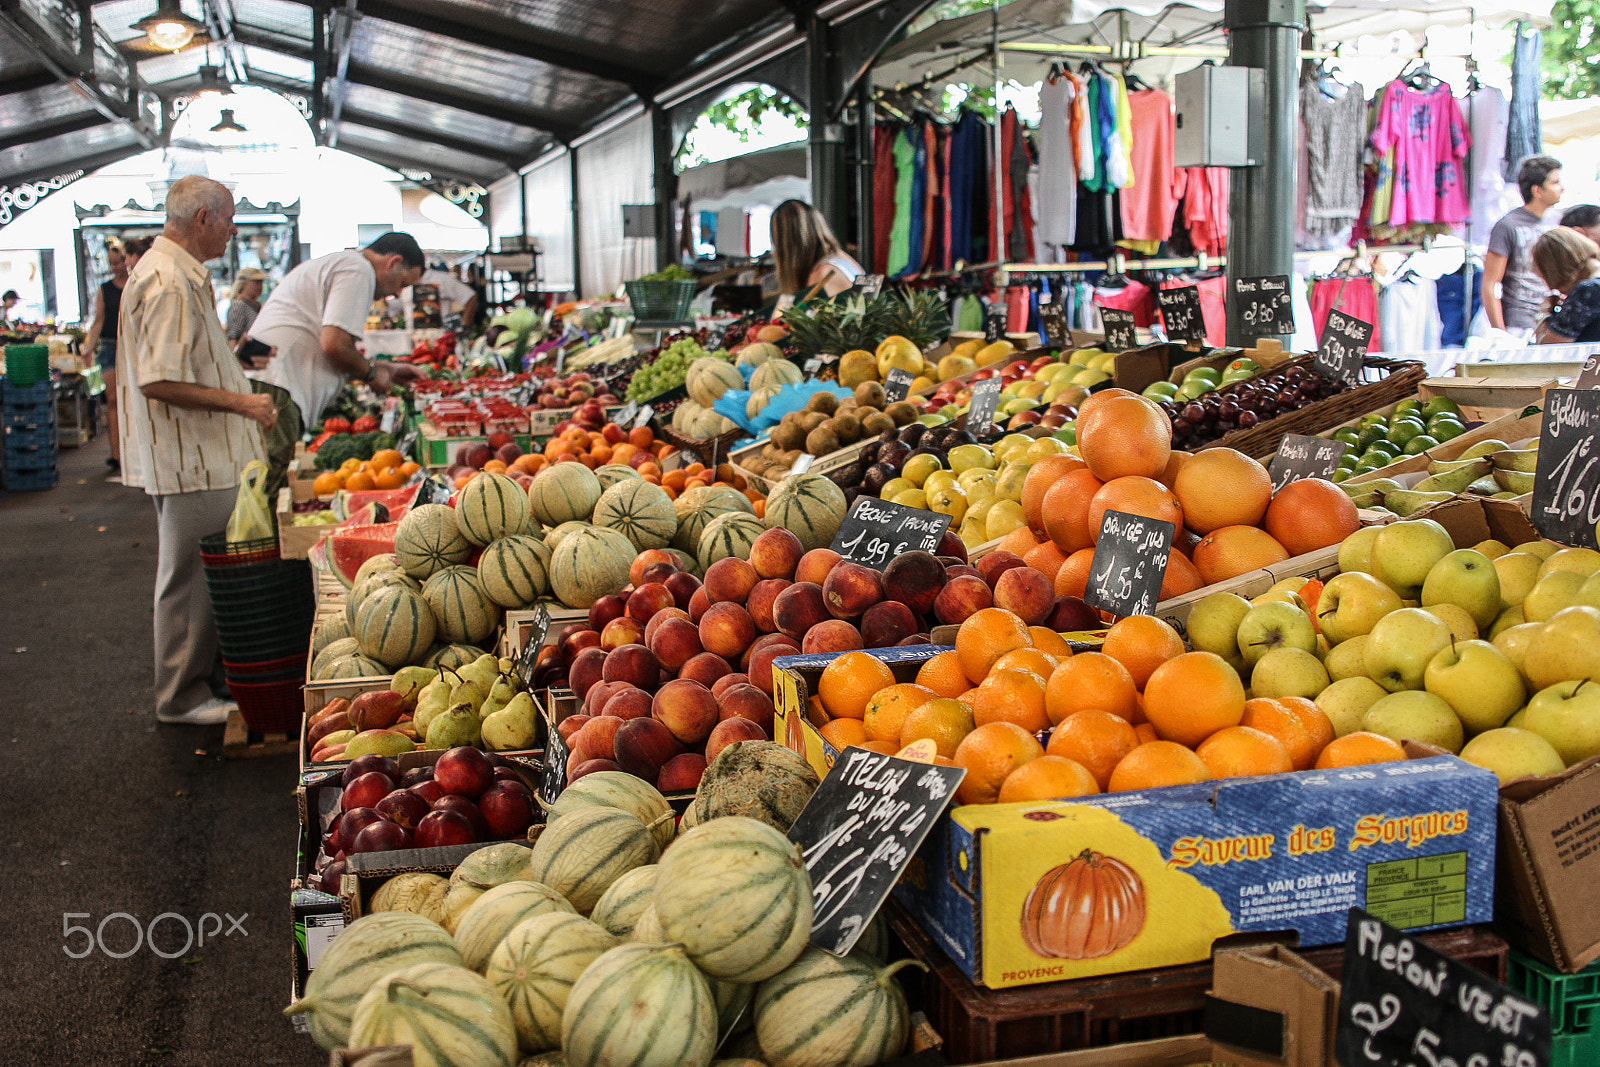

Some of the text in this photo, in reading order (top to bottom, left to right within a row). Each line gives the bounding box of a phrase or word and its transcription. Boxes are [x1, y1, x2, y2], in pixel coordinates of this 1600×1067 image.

[1166, 809, 1468, 872] Saveur des Sorgues
[1240, 870, 1357, 897] EARL VAN DER VALK
[1002, 966, 1065, 982] PROVENCE
